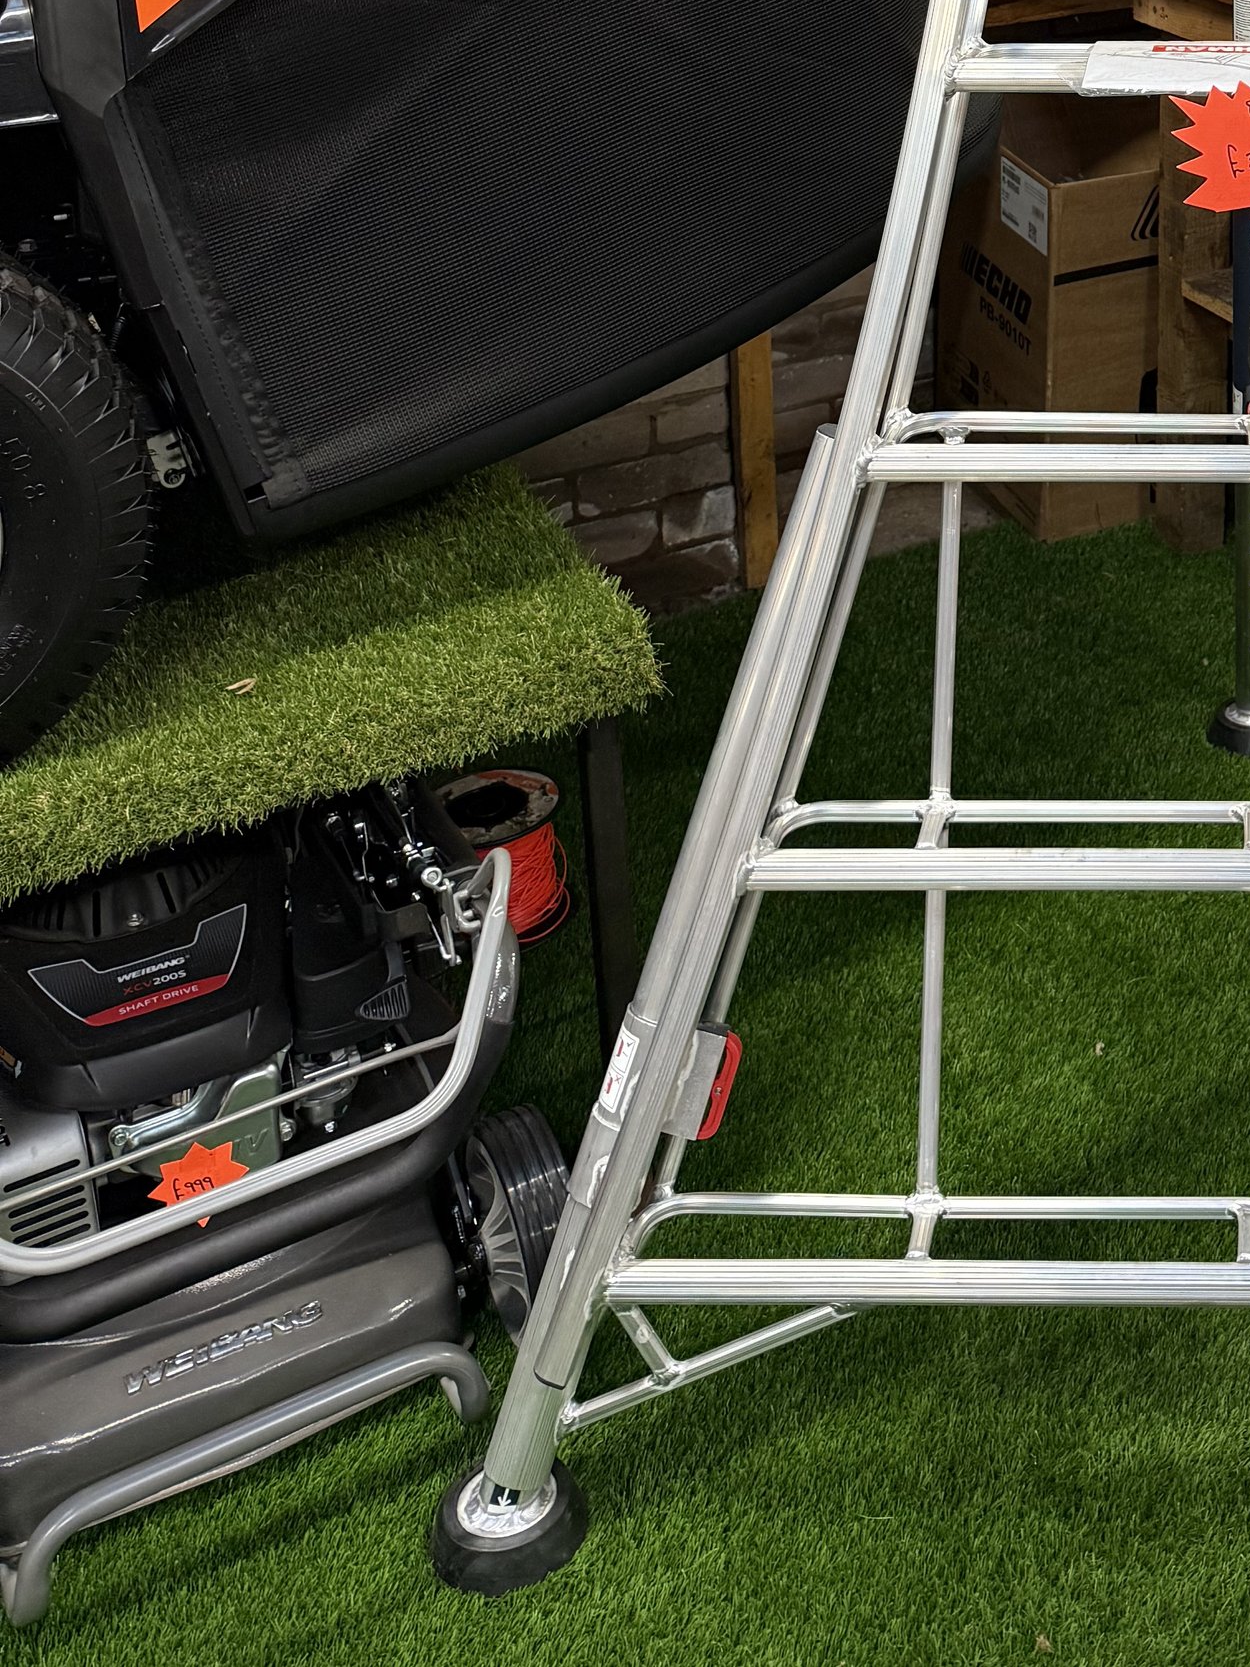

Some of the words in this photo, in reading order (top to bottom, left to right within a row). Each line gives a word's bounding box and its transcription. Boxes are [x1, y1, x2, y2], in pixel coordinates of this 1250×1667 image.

[976, 255, 1032, 325] ECHO
[980, 296, 1032, 357] PB-9010T
[117, 956, 186, 983] WEIBANG
[123, 969, 187, 996] XCV200S
[118, 995, 160, 1015] SHAFT
[162, 984, 199, 1001] DRIVE
[172, 1176, 215, 1201] £999
[123, 1299, 324, 1397] WEIBANG
